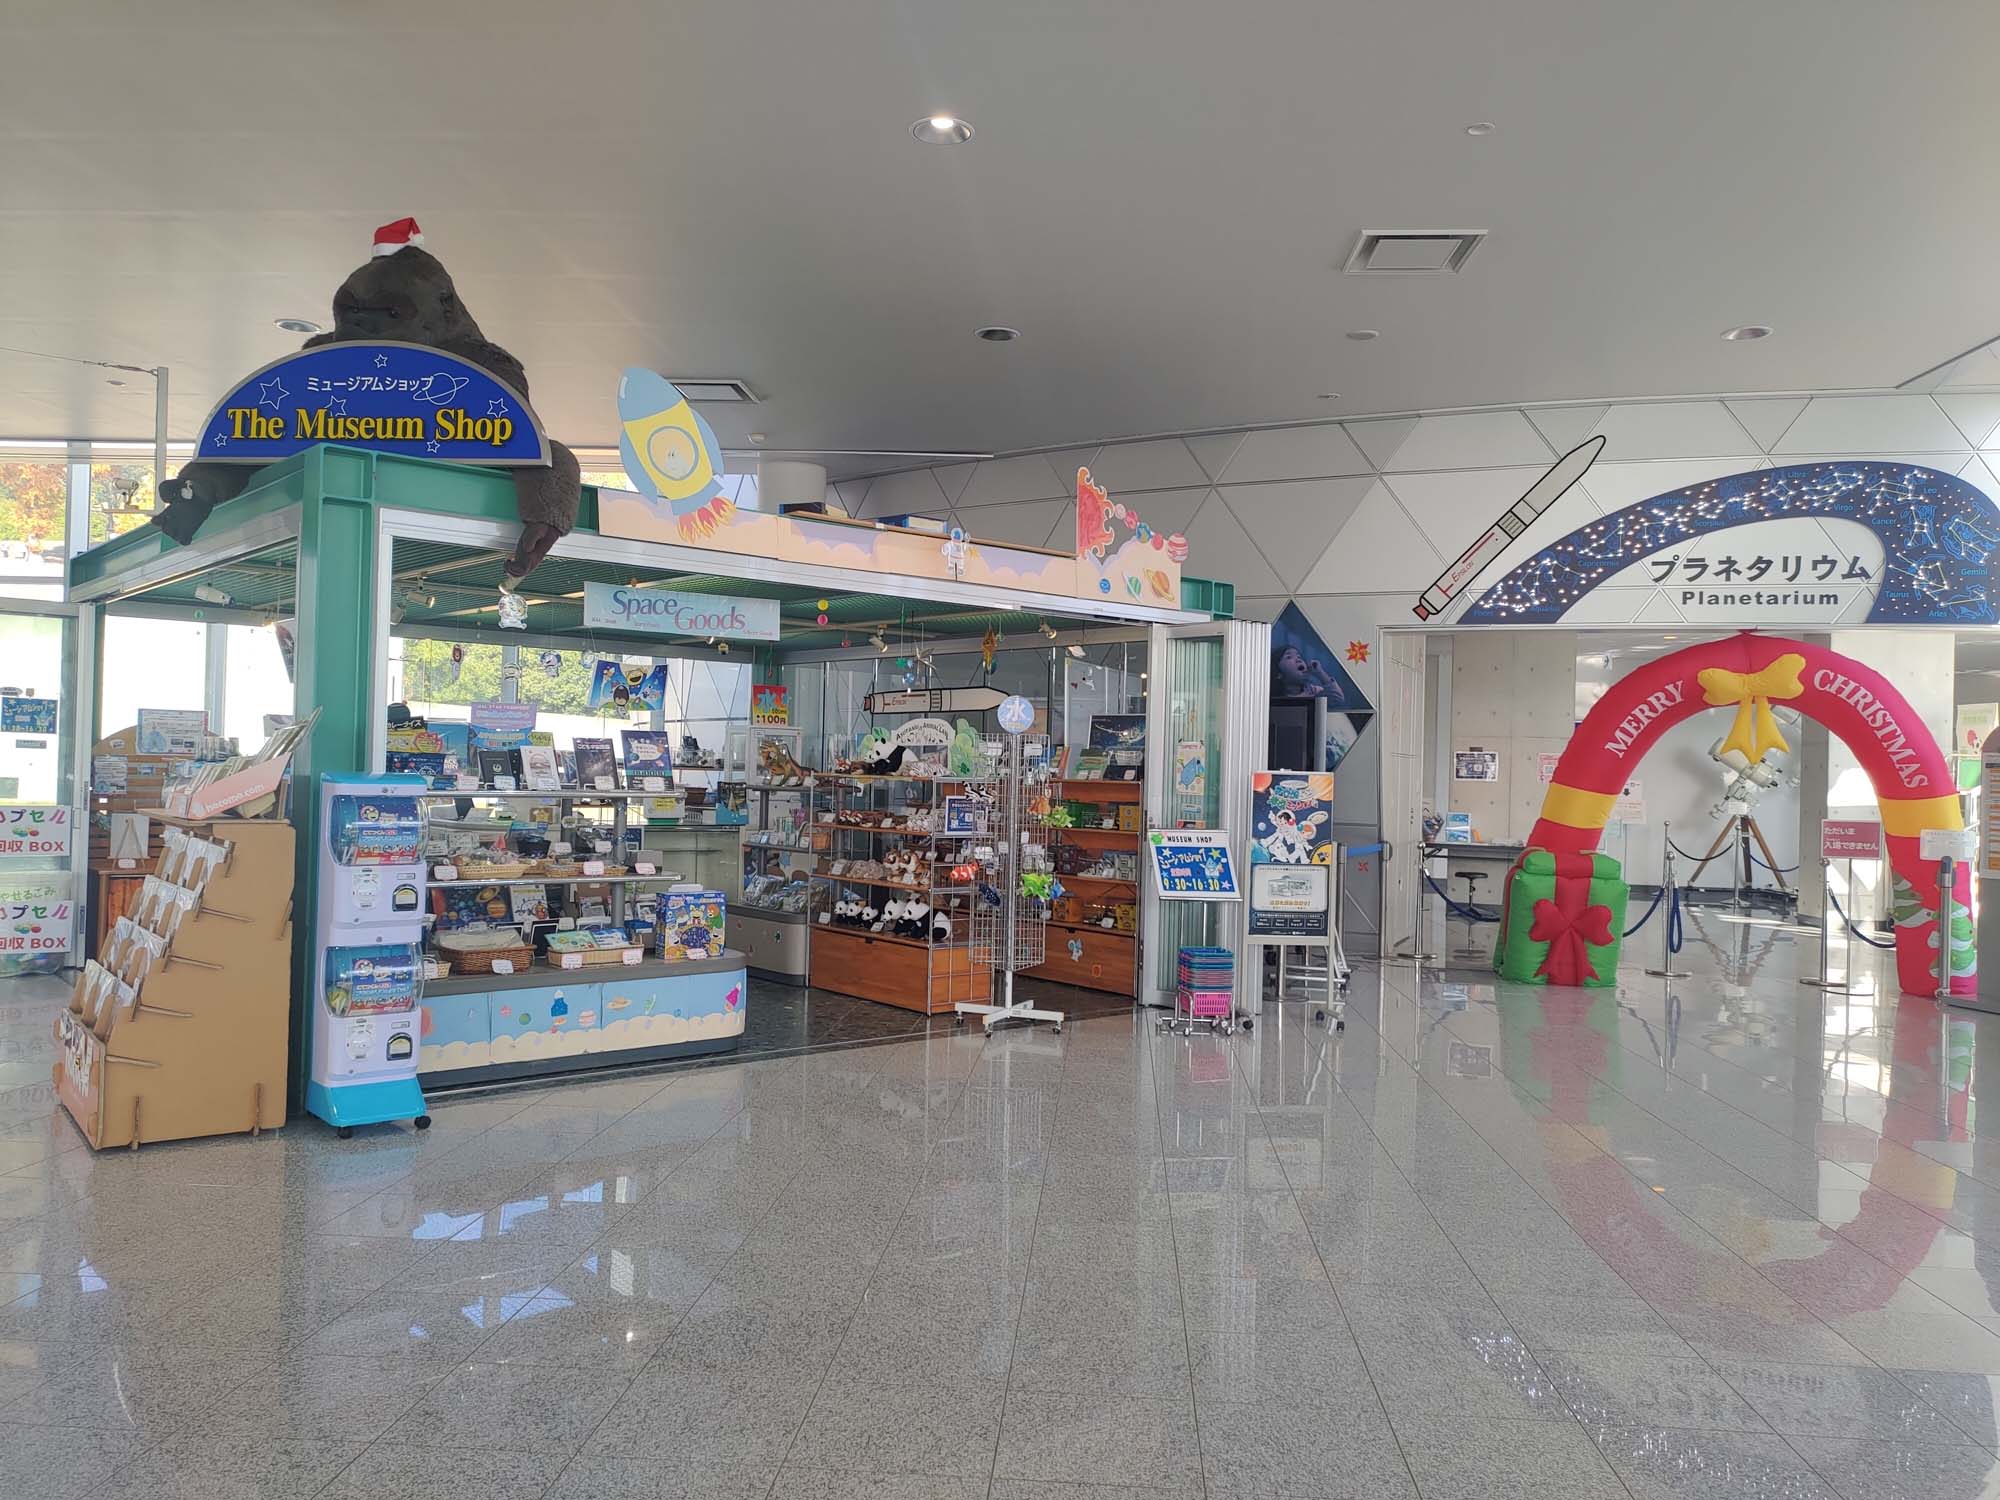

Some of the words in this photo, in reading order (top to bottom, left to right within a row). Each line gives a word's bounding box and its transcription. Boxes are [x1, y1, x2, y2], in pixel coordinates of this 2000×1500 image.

[307, 376, 433, 392] ミュージアムショップ
[227, 407, 283, 440] The
[295, 407, 424, 440] Museum
[434, 408, 512, 446] Shop
[1833, 504, 1854, 512] Virgo
[1871, 518, 1897, 526] Cancer
[1651, 554, 1872, 583] プラネタリウム
[1961, 568, 1988, 576] Gemini
[1682, 591, 1839, 605] Planetarium
[1885, 590, 1909, 598] Taurus
[611, 590, 678, 621] Space
[674, 606, 746, 631] Goods
[1604, 679, 1684, 760] MERRY
[1813, 668, 1928, 790] CHRISTMAS
[1824, 827, 1856, 835] ただいま
[29, 841, 65, 852] BOX
[1824, 841, 1878, 850] 入場できません
[30, 937, 66, 949] BOX
